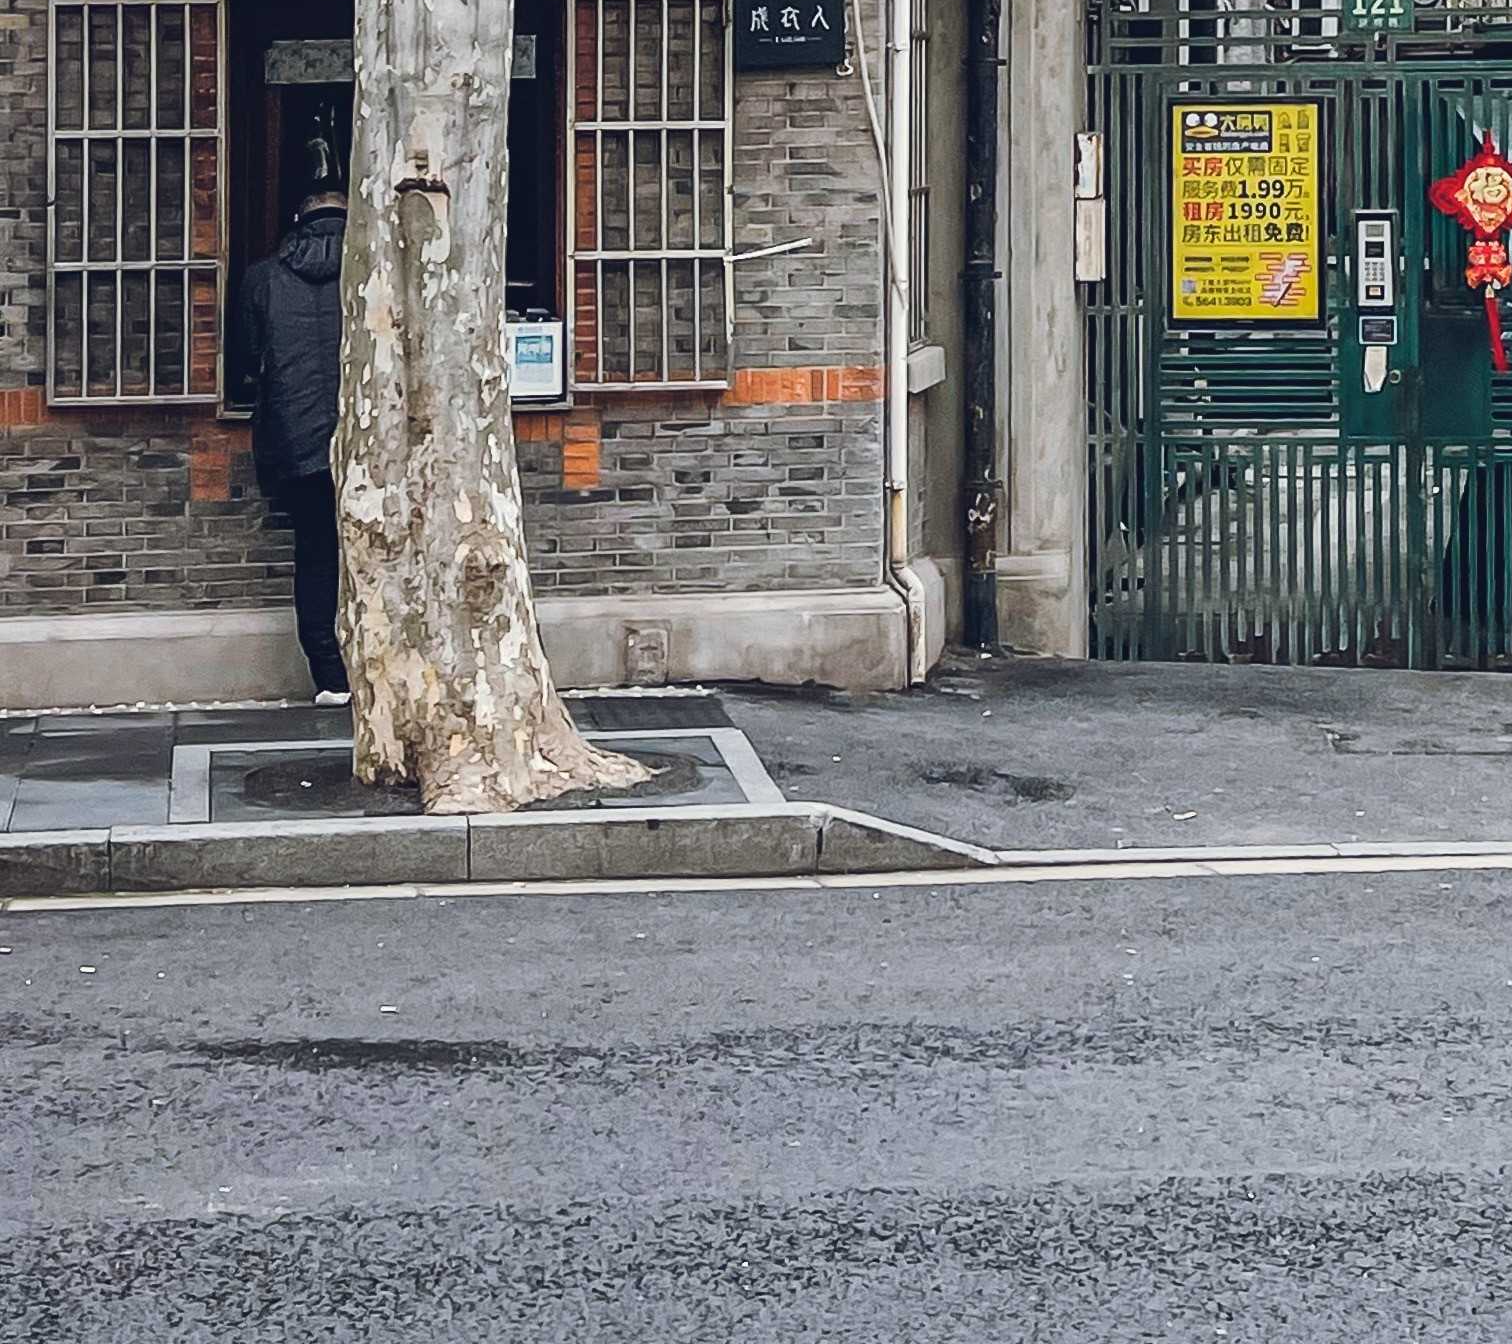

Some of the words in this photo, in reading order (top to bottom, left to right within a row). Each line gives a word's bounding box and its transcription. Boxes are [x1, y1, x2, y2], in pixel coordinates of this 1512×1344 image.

[1182, 156, 1310, 176] 买房仅需固定
